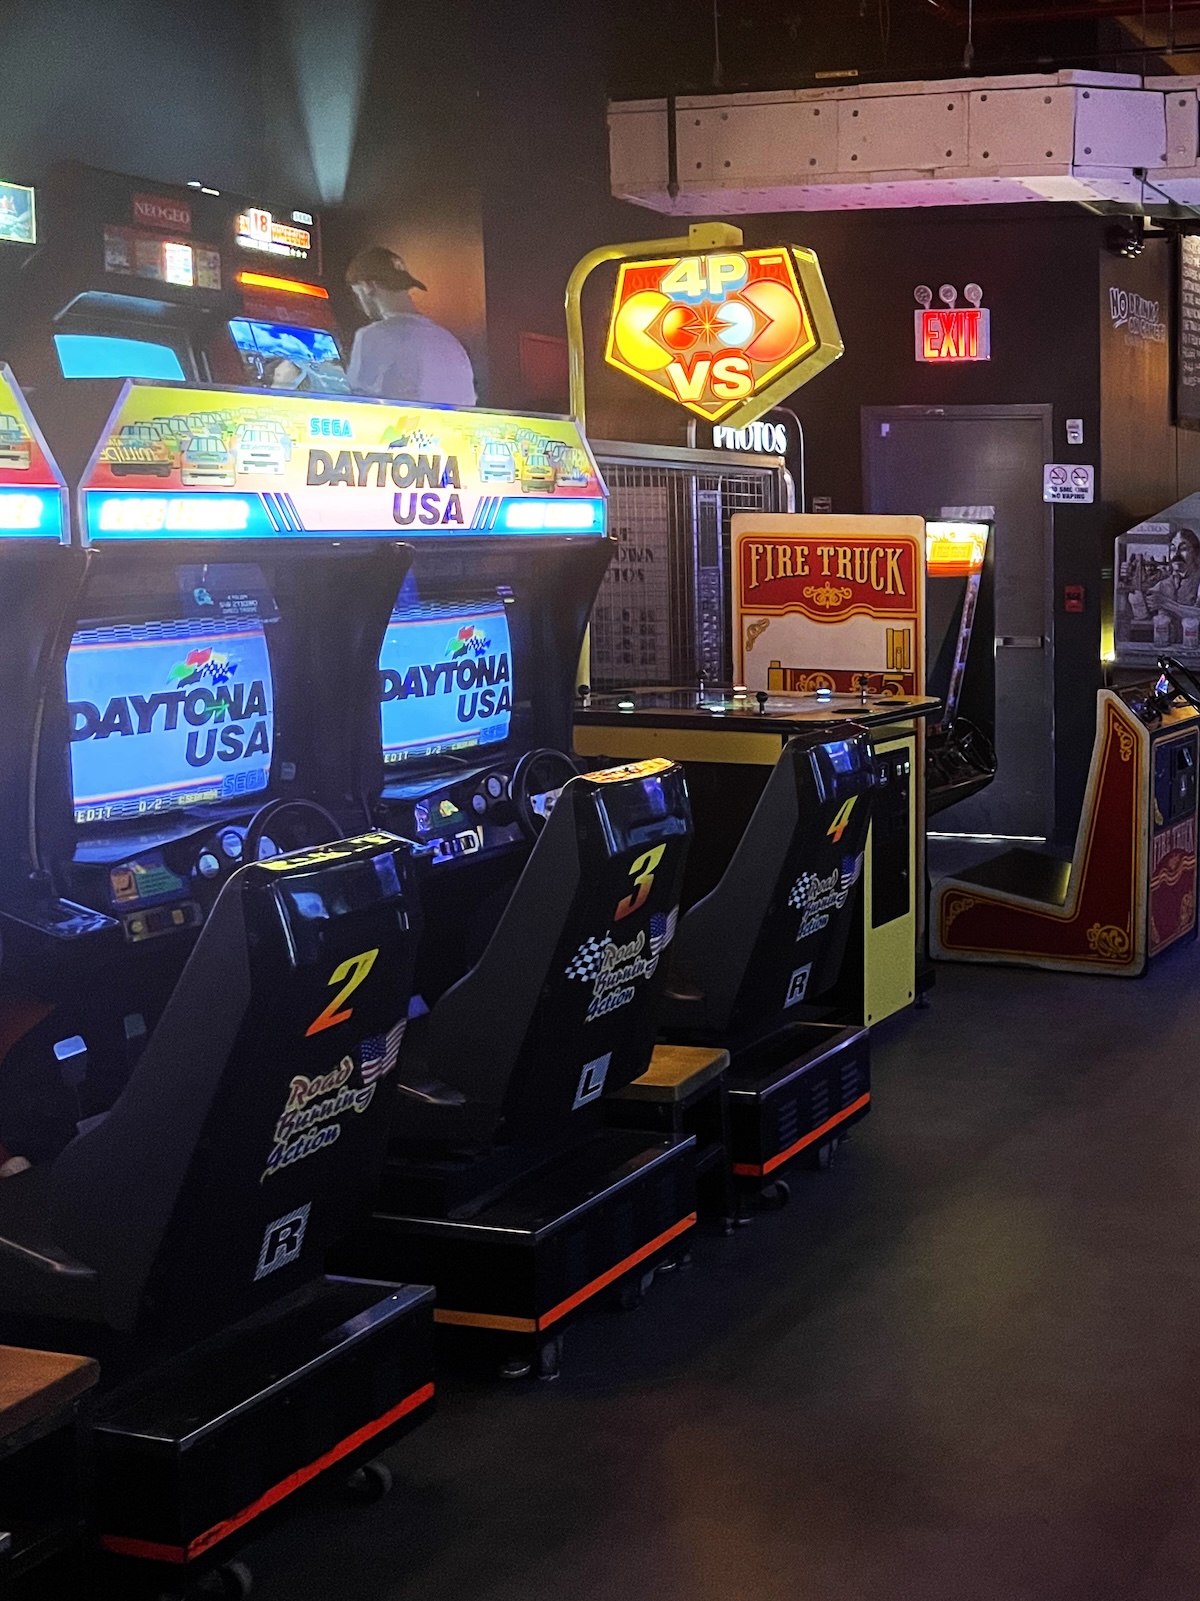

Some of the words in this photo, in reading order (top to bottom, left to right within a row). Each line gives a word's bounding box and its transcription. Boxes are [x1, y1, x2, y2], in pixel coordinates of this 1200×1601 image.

[254, 213, 268, 233] 18
[659, 253, 748, 299] 4P
[1109, 286, 1128, 320] NO
[922, 311, 982, 359] EXIT
[667, 354, 755, 403] VS
[310, 417, 353, 438] SEGA
[713, 423, 787, 454] PHOTOS
[306, 448, 461, 489] DAYTONA
[392, 493, 465, 525] USA
[747, 541, 810, 591] FIRE
[816, 541, 906, 595] TRUCK
[379, 653, 510, 703] DAYTONA
[69, 680, 269, 742] DAYTONA
[457, 686, 512, 723] USA
[185, 721, 270, 767] USA
[222, 768, 267, 795] SEGA
[827, 795, 858, 843] 4
[614, 843, 667, 923] 3
[810, 867, 839, 902] Road
[796, 911, 829, 941] Action
[602, 930, 646, 970] Road
[305, 948, 379, 1038] 2
[594, 952, 659, 998] Burning
[788, 973, 807, 1001] R
[585, 985, 635, 1024] Action
[286, 1055, 354, 1108] Road
[581, 1066, 602, 1097] L
[275, 1081, 377, 1144] Burning
[260, 1122, 341, 1186] Action
[265, 1227, 302, 1268] R
